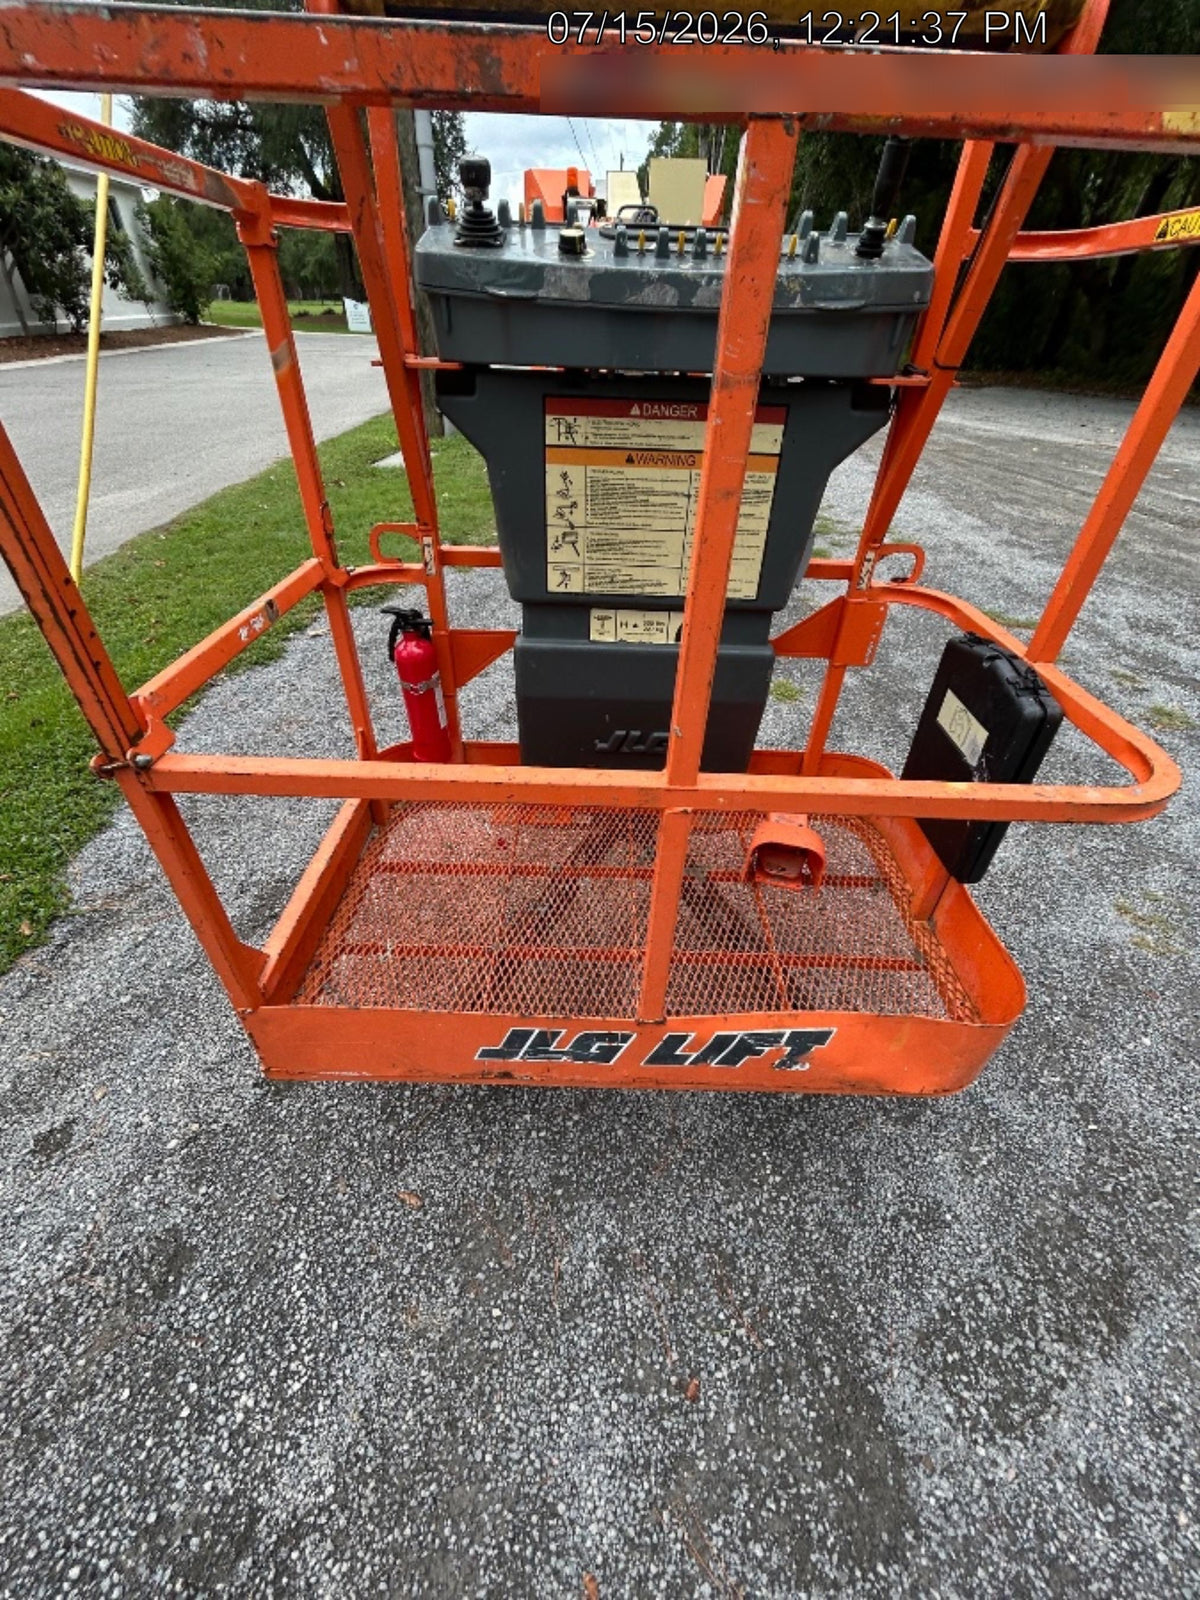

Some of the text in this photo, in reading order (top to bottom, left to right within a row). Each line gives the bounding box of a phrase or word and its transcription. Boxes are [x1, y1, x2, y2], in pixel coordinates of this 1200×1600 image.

[642, 404, 698, 418] DANGER
[635, 452, 696, 467] WARNING
[474, 1028, 838, 1071] JLG LIFT
